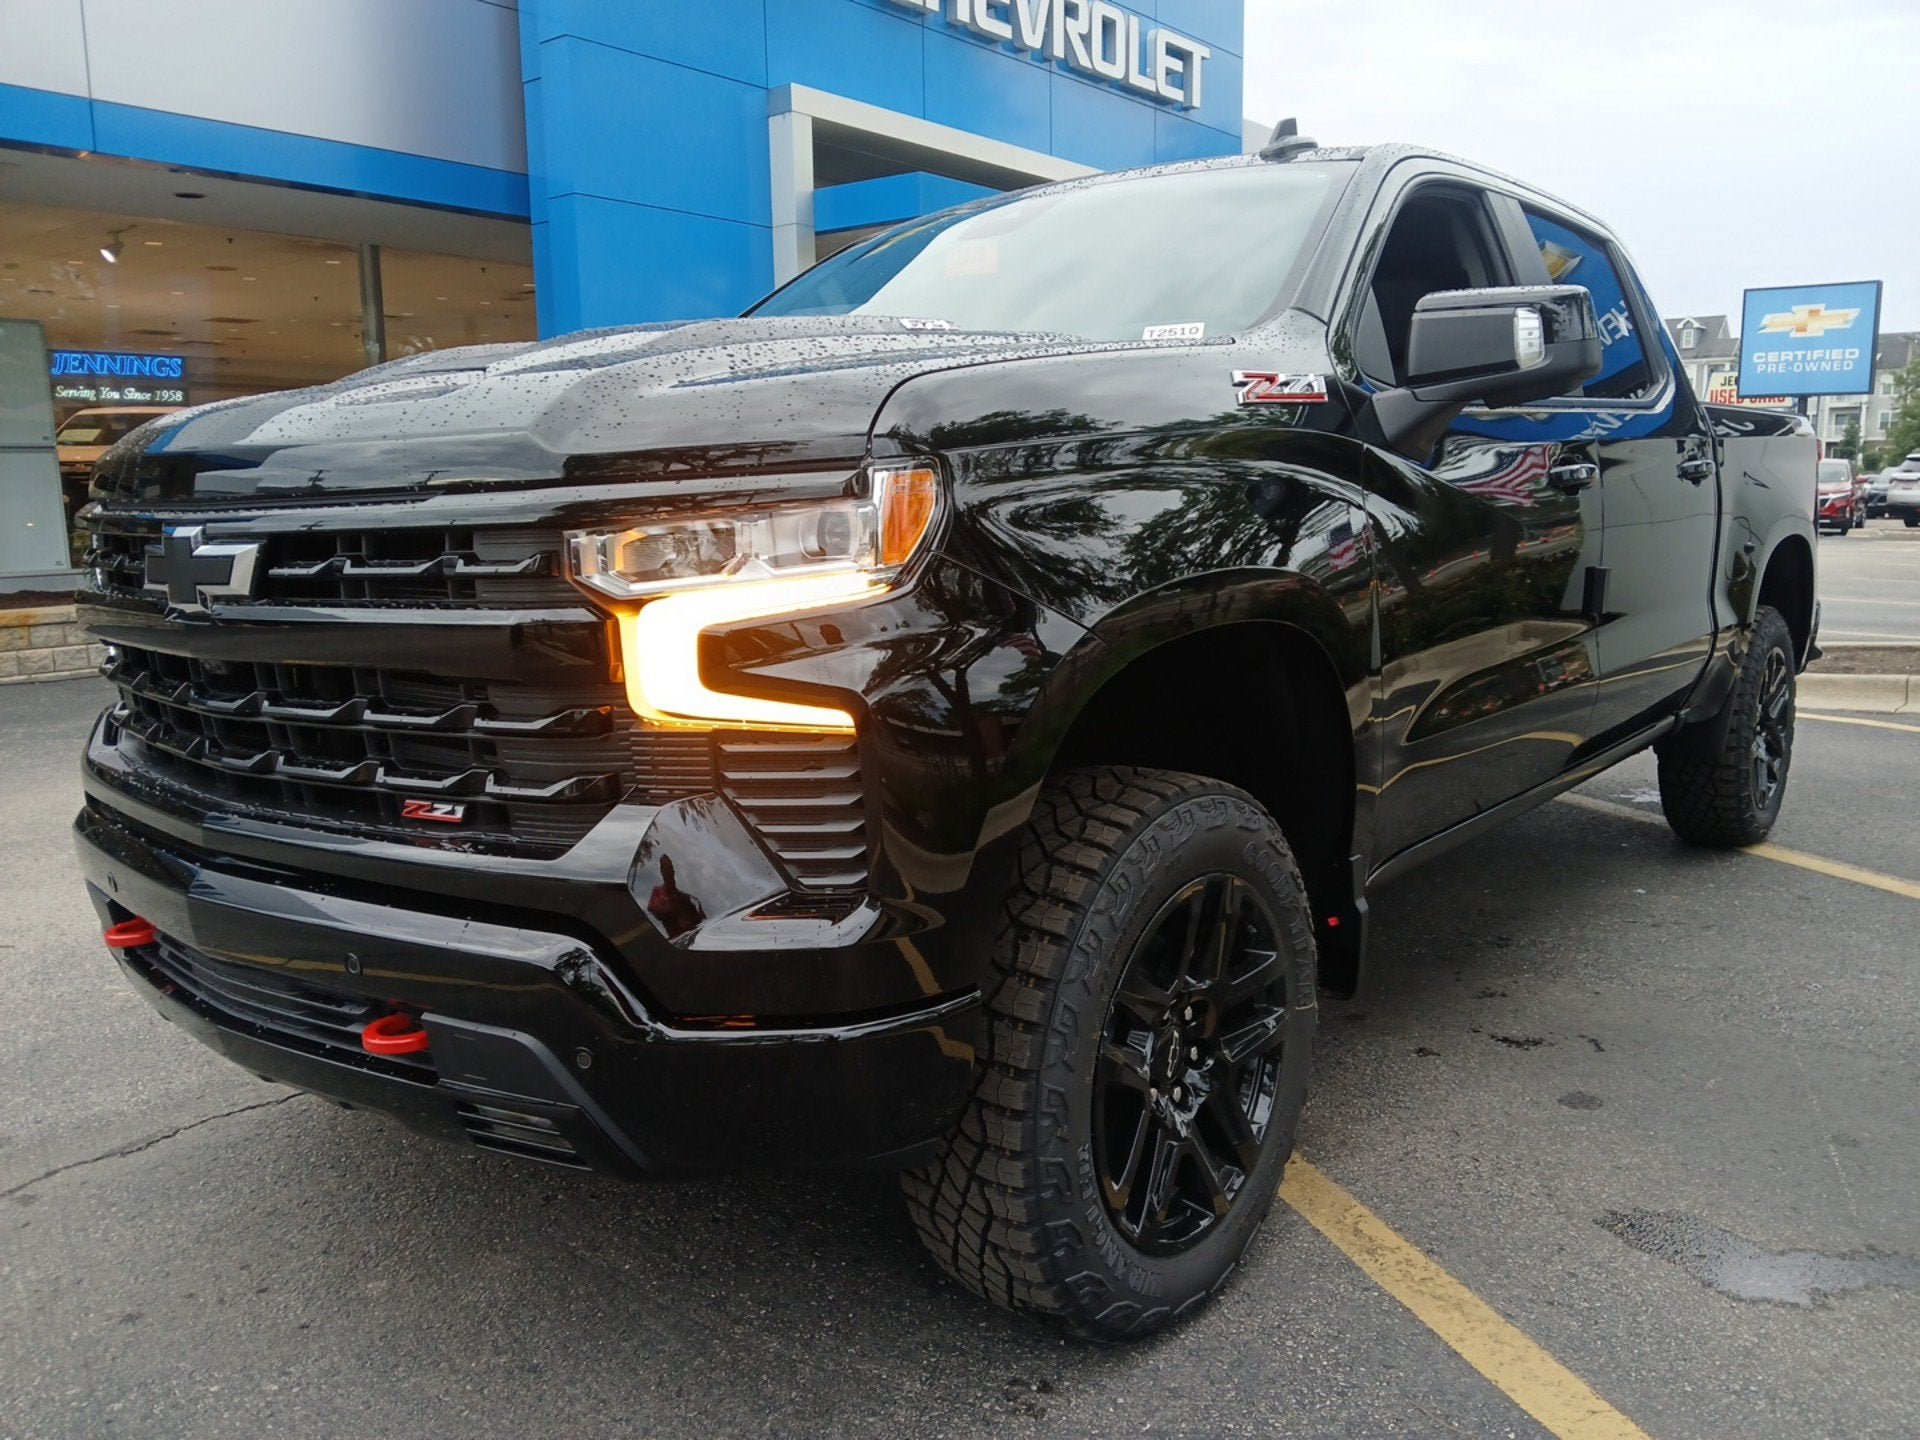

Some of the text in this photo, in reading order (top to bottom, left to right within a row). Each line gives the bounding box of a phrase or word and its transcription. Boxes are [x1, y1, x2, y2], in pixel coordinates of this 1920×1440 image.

[888, 0, 1210, 109] EVROLET
[51, 352, 183, 378] JENNINGS
[1752, 348, 1860, 363] CERTIFIED
[1757, 360, 1853, 374] PRE-OWNED
[55, 385, 184, 402] Serving You Since 1958
[1231, 370, 1329, 404] Z71
[402, 800, 467, 823] Z71
[1242, 840, 1315, 1006] GOODYEAR
[1077, 1142, 1161, 1297] WRANGLER
